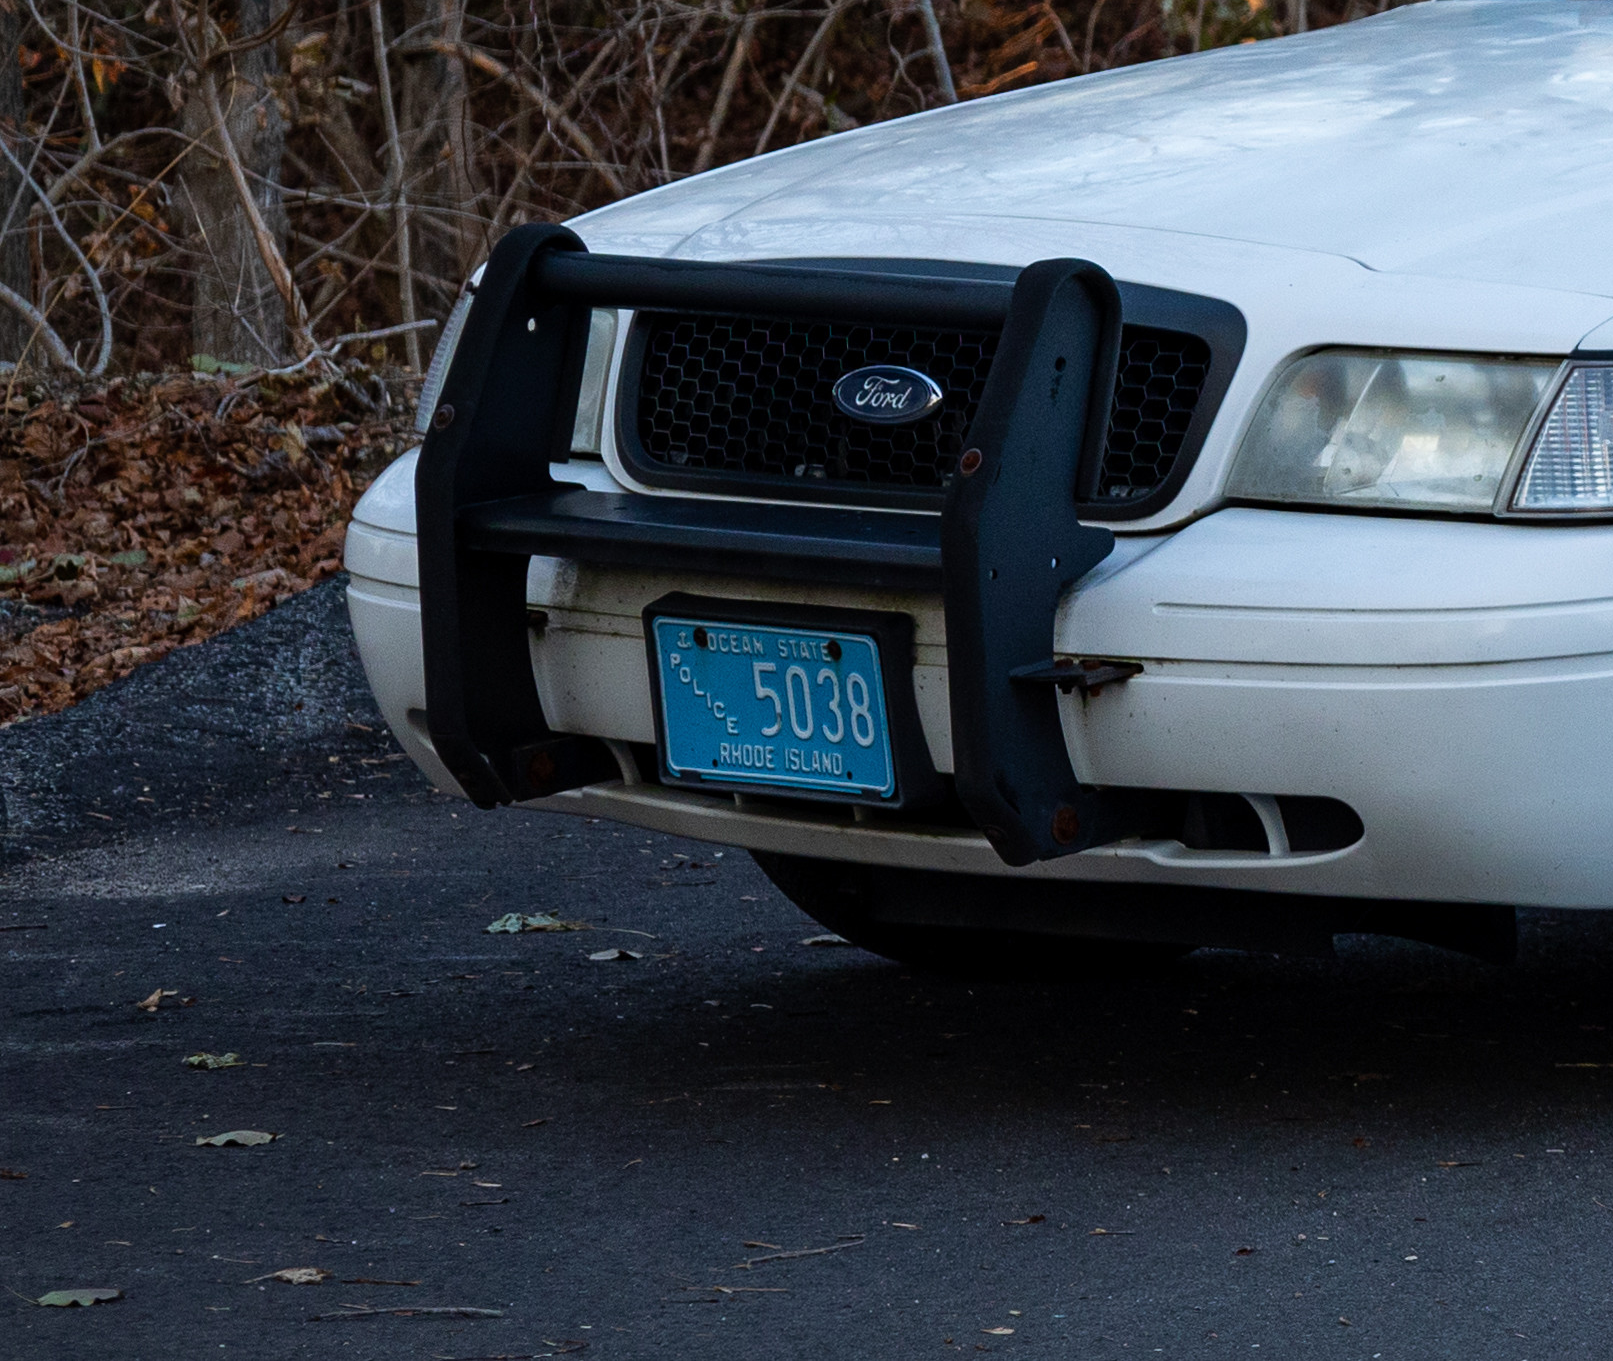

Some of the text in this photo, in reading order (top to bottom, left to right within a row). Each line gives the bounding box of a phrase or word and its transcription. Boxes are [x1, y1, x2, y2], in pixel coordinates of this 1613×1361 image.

[855, 376, 912, 409] Ford
[707, 632, 833, 663] OCEAN STATE
[669, 653, 739, 735] POLICE
[752, 661, 875, 748] 5038
[719, 742, 843, 776] RHODE ISLAND
